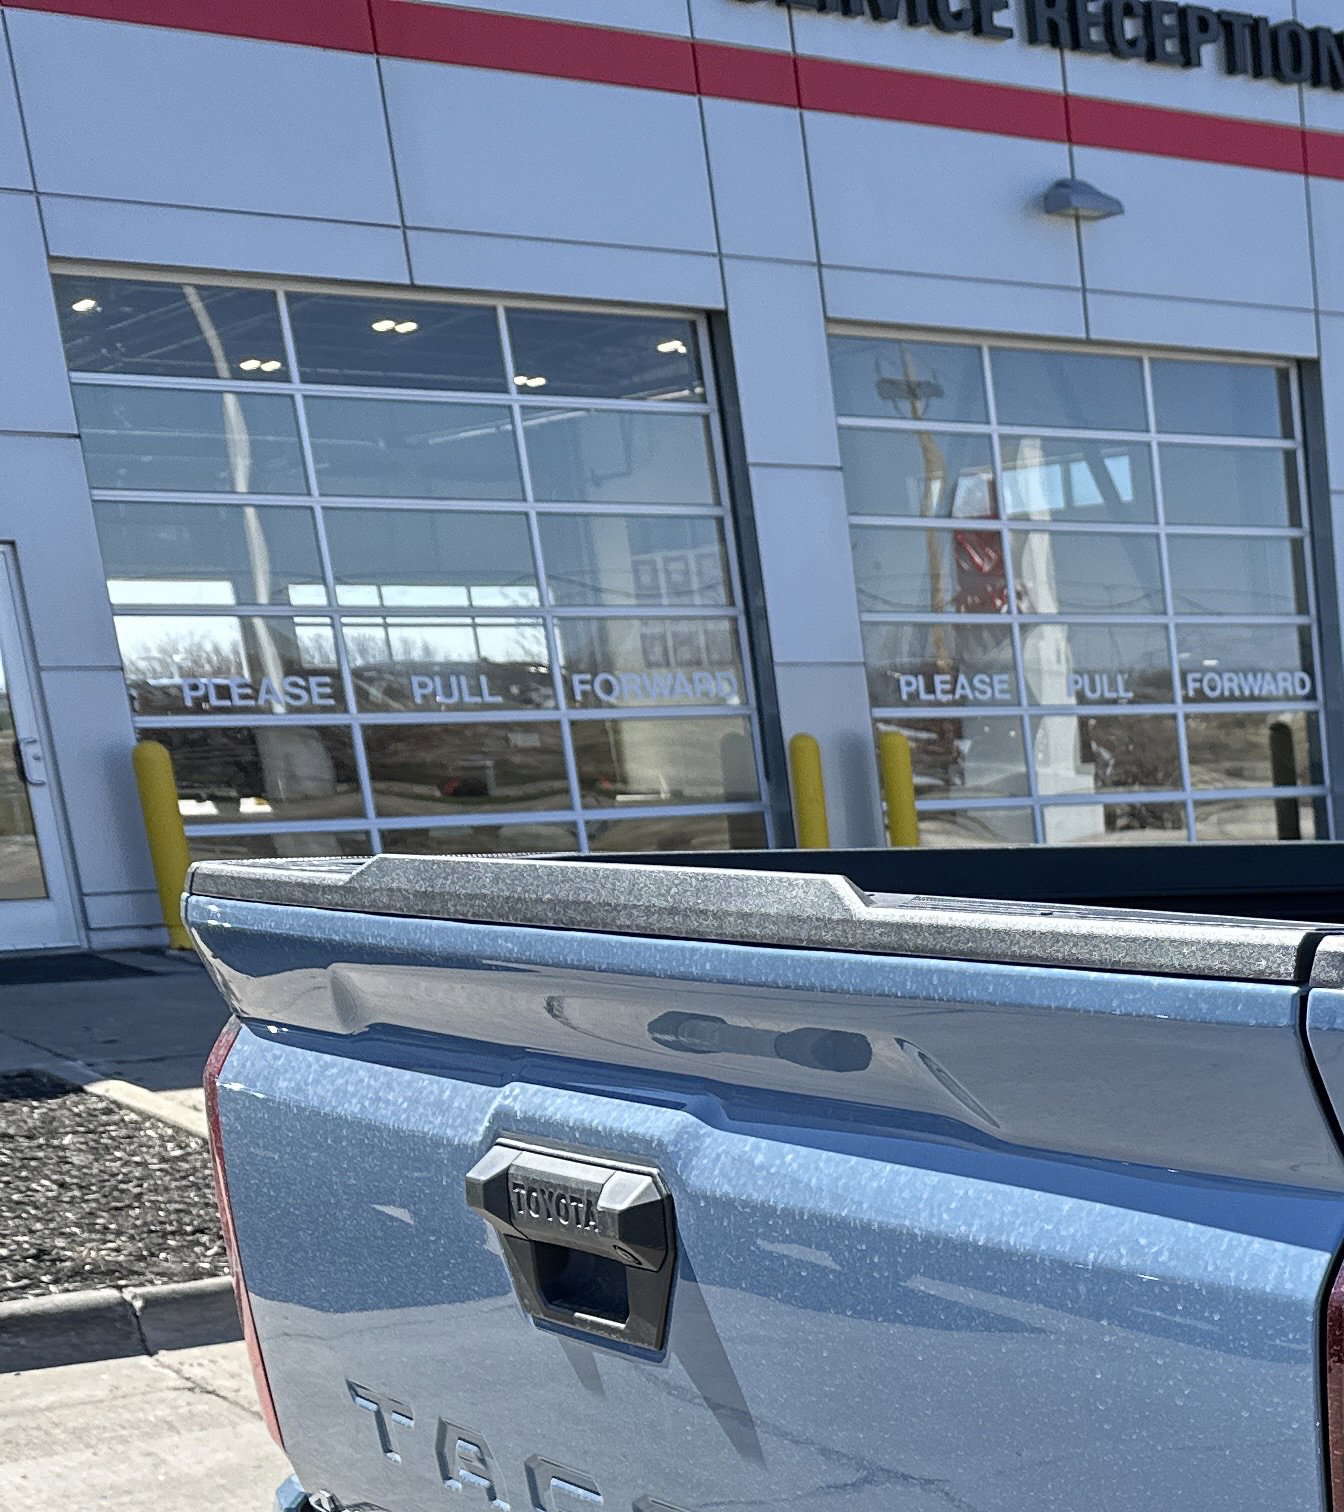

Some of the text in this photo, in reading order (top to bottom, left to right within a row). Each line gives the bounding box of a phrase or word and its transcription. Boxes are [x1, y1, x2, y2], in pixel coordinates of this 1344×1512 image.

[182, 671, 738, 708] PLEASE PULL FORWARD
[900, 671, 1312, 701] PLEASE PULL FORWARD
[511, 1182, 600, 1233] TOYOTA
